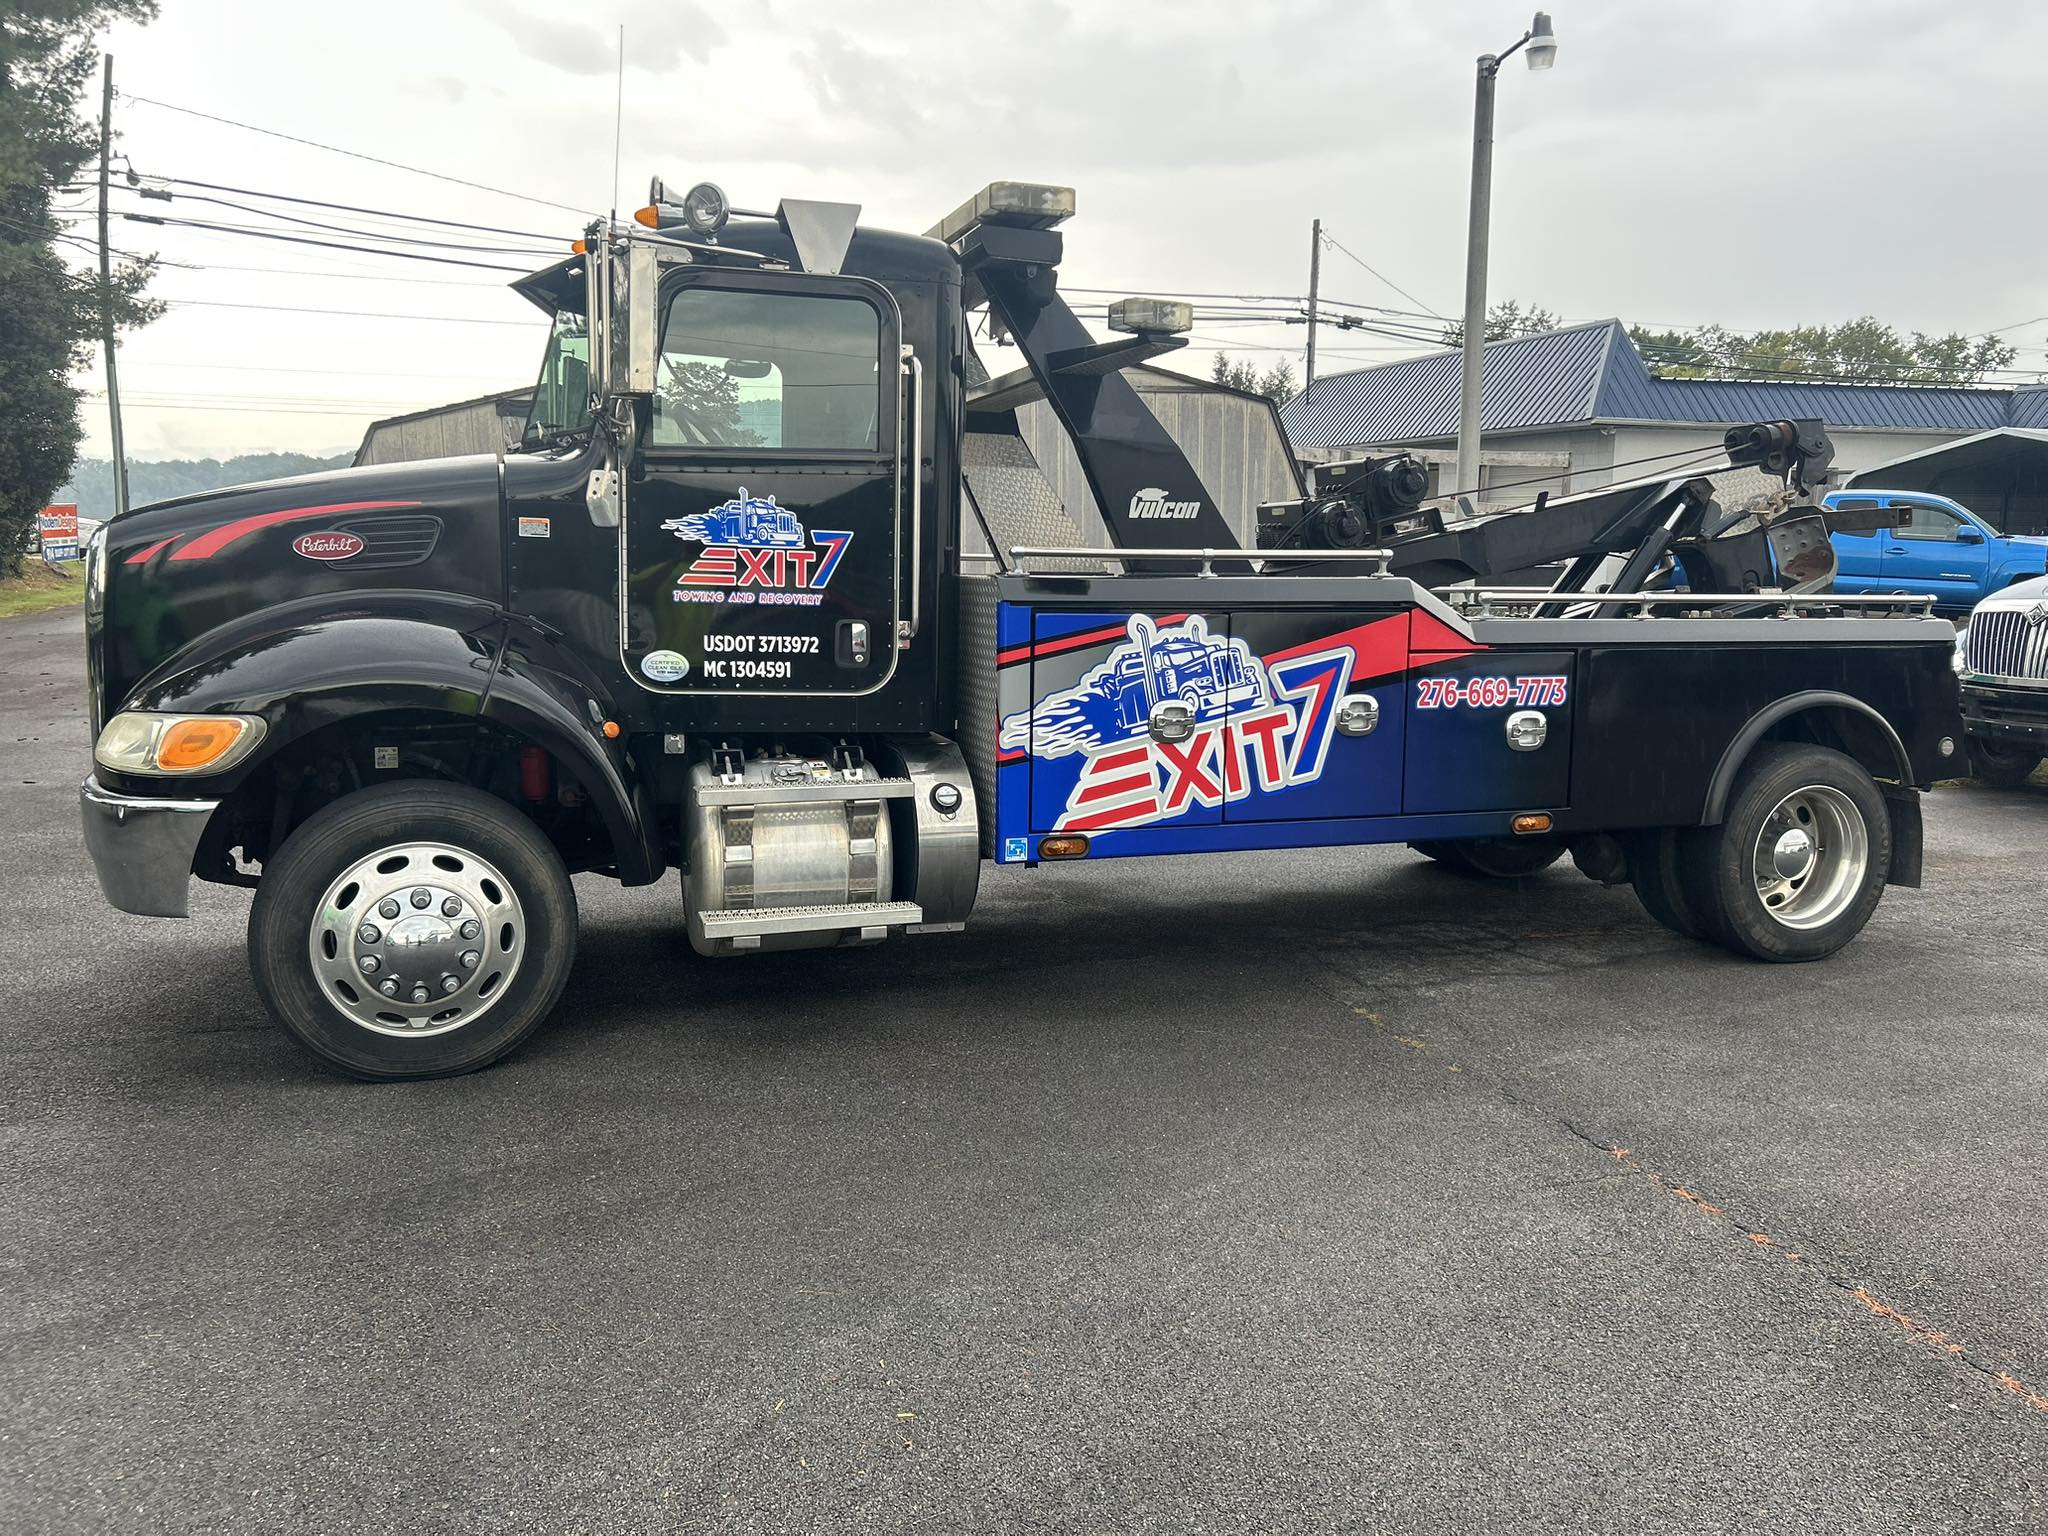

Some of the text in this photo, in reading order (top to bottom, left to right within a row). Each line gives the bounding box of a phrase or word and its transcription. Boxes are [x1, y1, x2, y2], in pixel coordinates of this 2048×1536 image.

[1128, 496, 1201, 519] Vulcan
[301, 537, 357, 553] Peterbilt
[677, 530, 855, 589] EXIT 7
[673, 590, 824, 606] TOWING AND RECOVERY
[703, 635, 819, 653] USDOT 3713972
[703, 661, 792, 678] MC 1304591
[1416, 676, 1568, 708] 276-669-7773
[1054, 650, 1353, 835] EXIT 7
